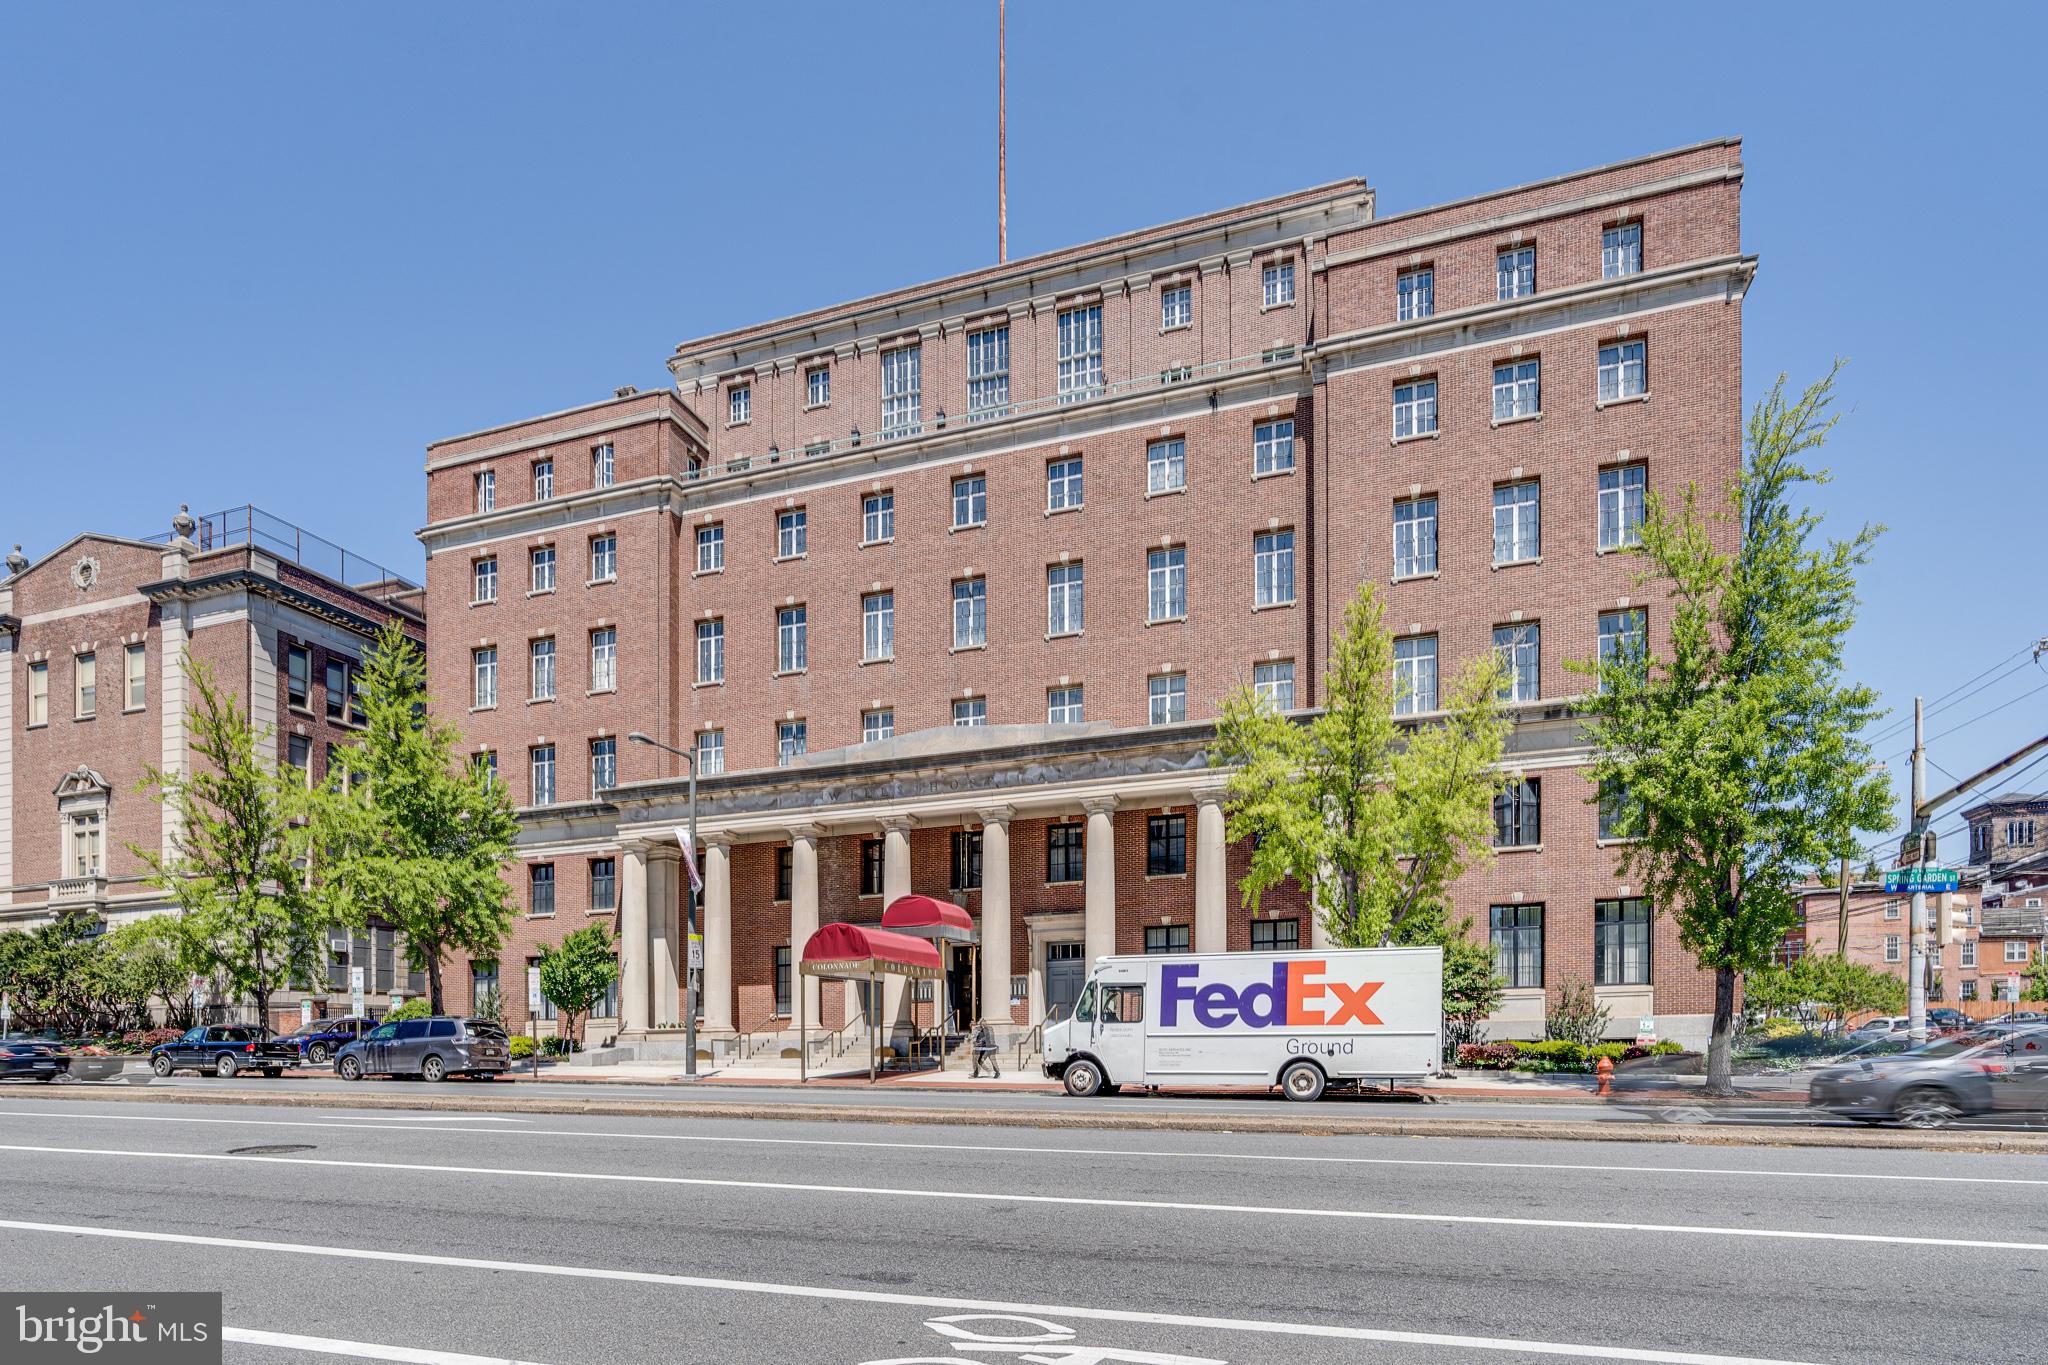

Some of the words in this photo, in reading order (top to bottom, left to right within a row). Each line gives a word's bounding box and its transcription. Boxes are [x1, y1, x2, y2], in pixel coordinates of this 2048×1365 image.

[1887, 873, 1914, 884] SPRING
[1917, 872, 1947, 883] GARDEN
[692, 949, 700, 959] 15
[812, 960, 860, 971] COLONNADE
[1159, 960, 1385, 1029] FedEx
[1286, 1038, 1354, 1055] Ground
